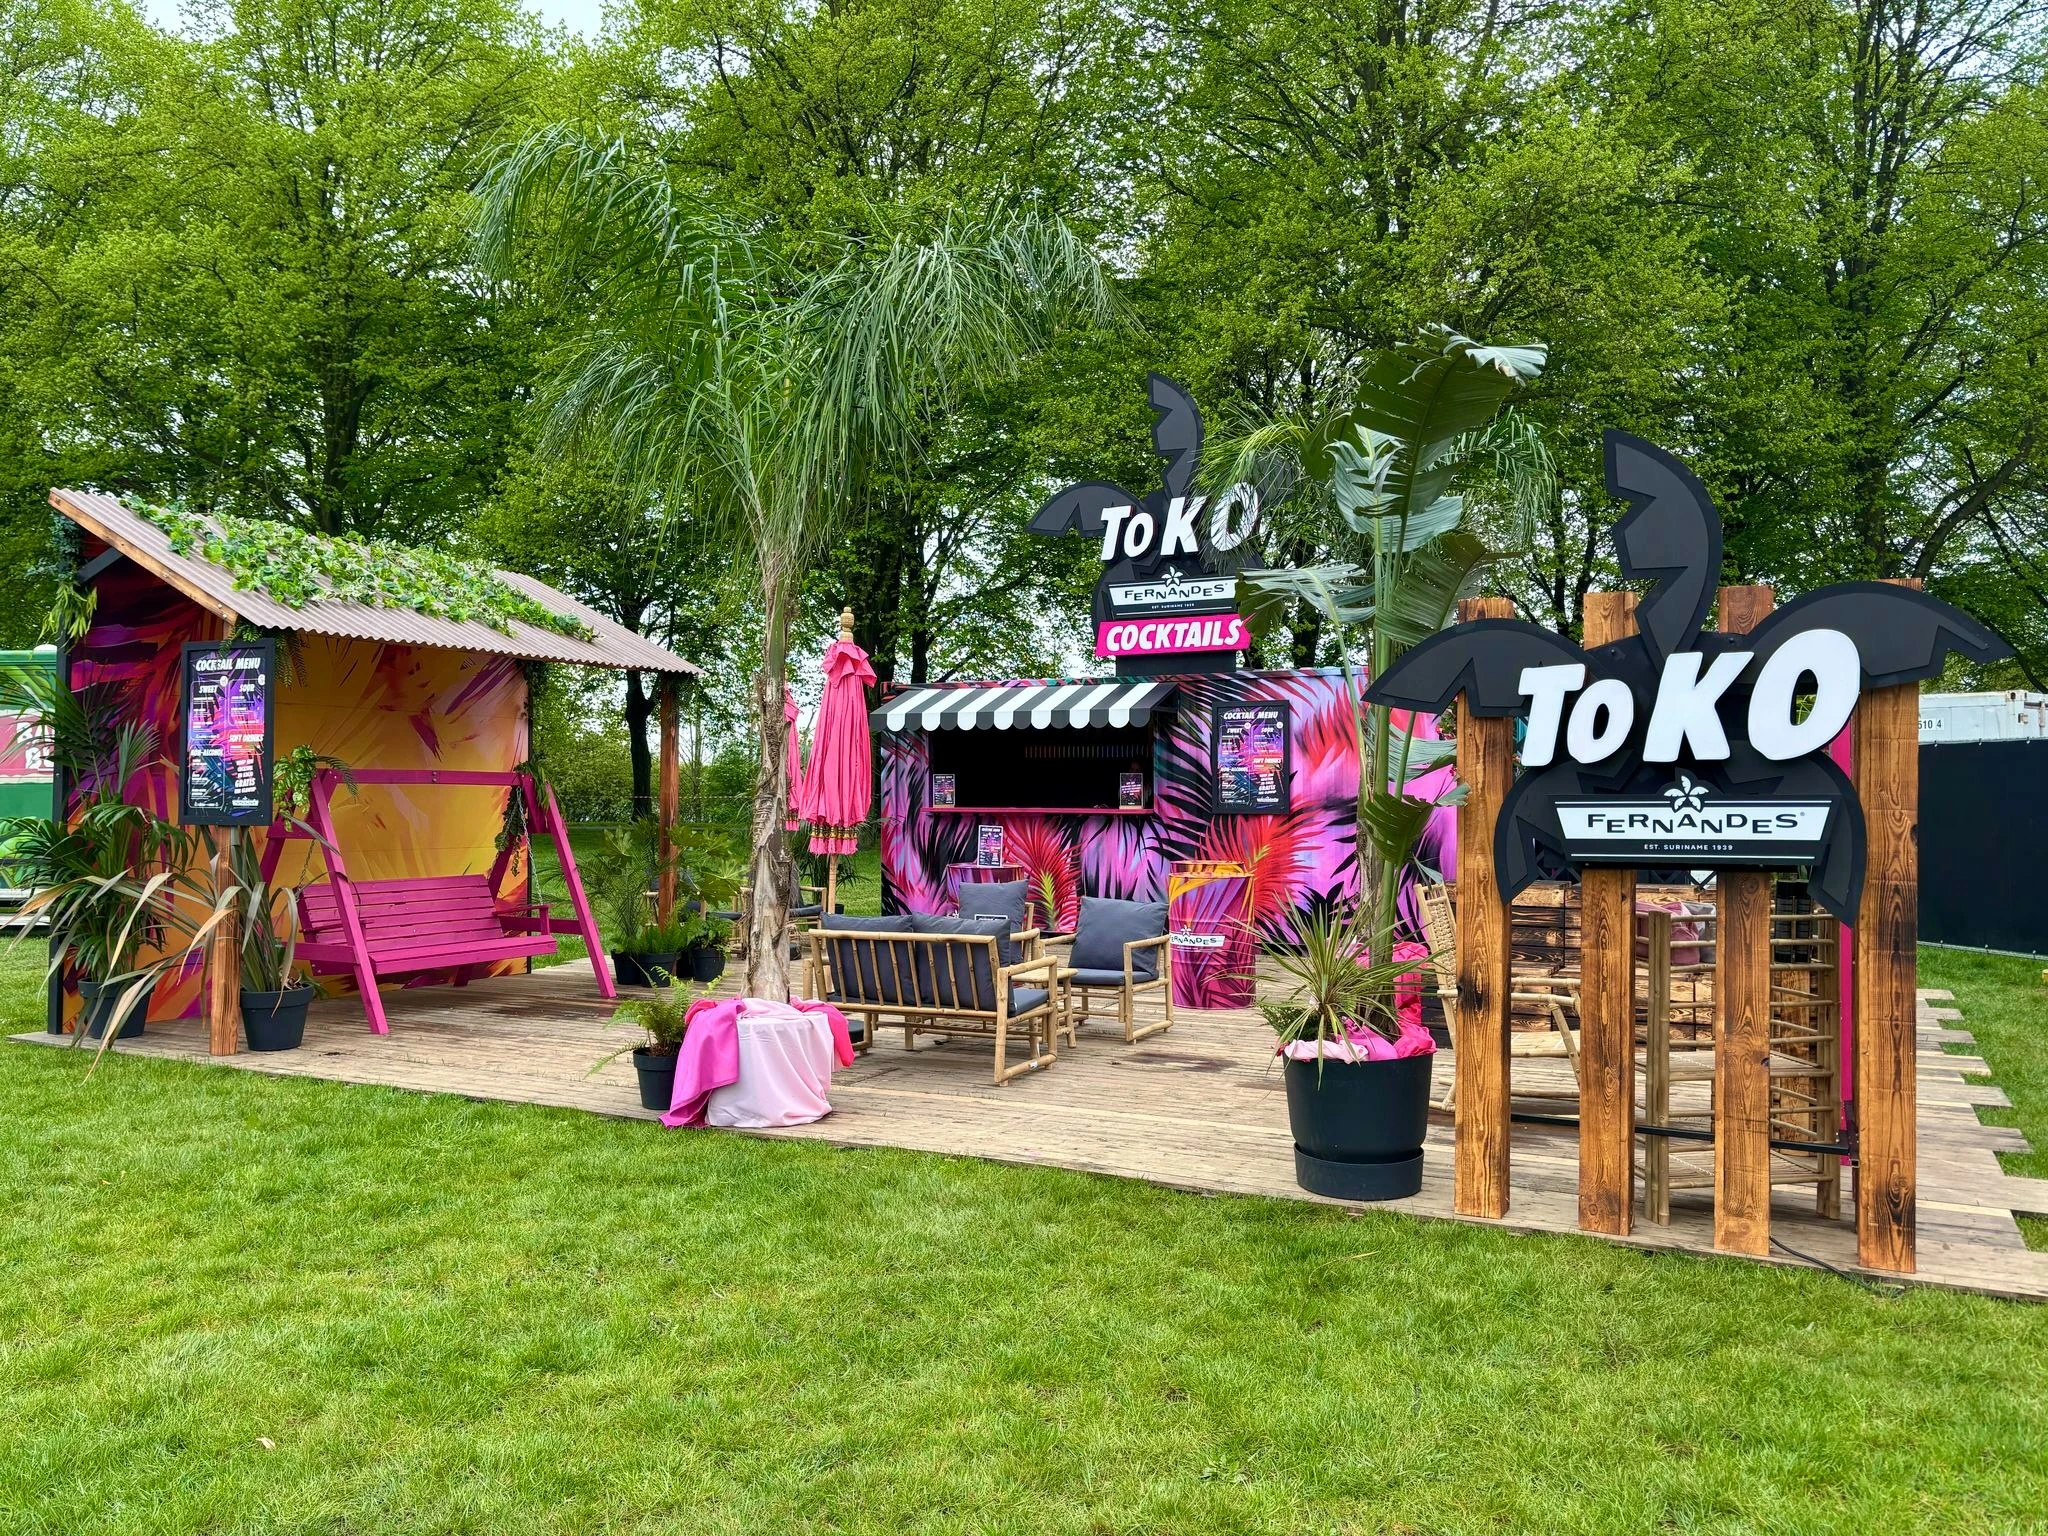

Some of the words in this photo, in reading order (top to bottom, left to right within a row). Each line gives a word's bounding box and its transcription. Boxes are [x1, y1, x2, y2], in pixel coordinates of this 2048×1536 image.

[1124, 583, 1225, 601] FERNANDES
[1106, 618, 1243, 651] COCKTAILS
[235, 657, 261, 669] MENU
[1587, 813, 1799, 835] FERNANDES
[1170, 935, 1217, 946] ERNANDES
